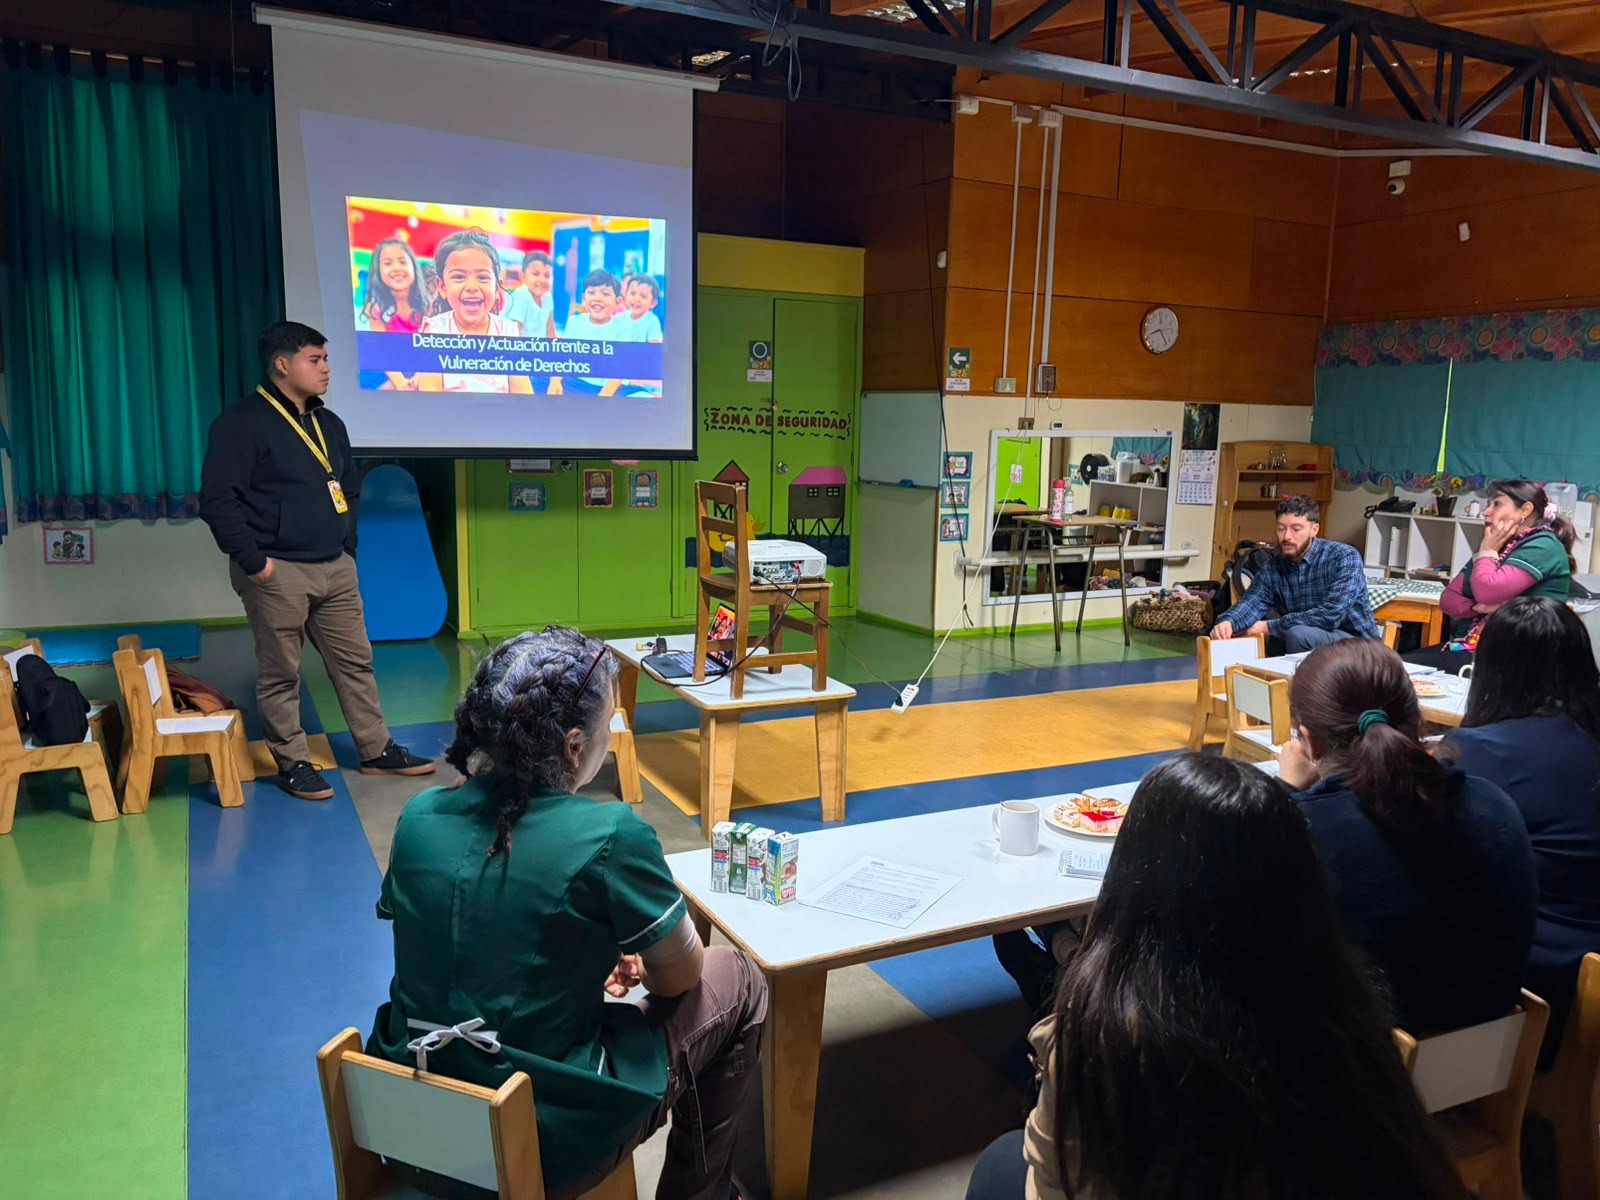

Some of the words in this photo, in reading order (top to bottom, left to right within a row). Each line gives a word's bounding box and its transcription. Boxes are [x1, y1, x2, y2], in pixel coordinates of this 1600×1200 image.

[412, 333, 477, 350] Detección
[478, 339, 486, 353] y
[488, 336, 550, 352] Actuación
[551, 338, 590, 355] frente
[591, 343, 600, 355] a
[602, 340, 614, 356] la
[438, 354, 514, 371] Vulneración
[515, 357, 531, 372] de
[533, 358, 591, 374] Derechos
[710, 411, 751, 426] ZONA
[755, 414, 773, 427] DE
[777, 415, 847, 430] SEGURIDAD
